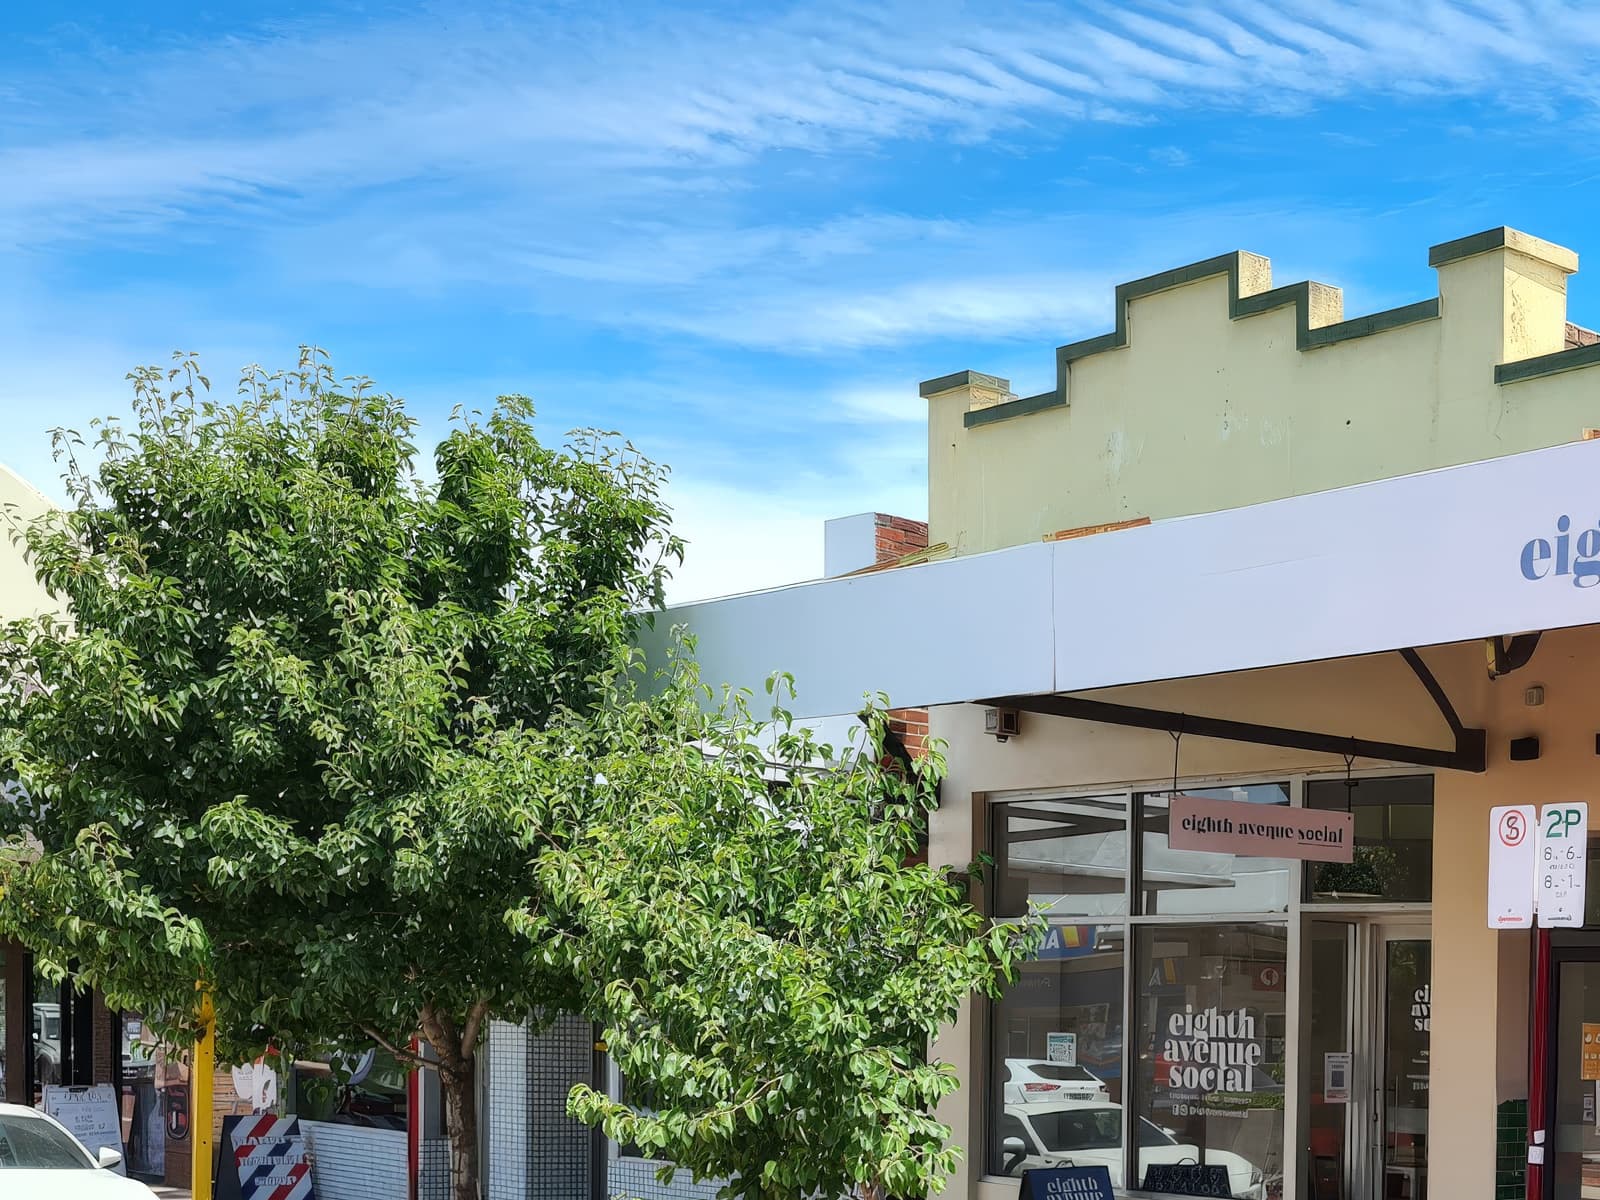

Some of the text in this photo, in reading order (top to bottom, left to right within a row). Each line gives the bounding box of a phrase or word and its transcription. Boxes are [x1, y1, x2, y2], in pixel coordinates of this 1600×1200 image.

[1181, 814, 1343, 844] eighth avenue social
[1545, 808, 1582, 839] 2P
[1168, 1004, 1255, 1042] eighth
[1163, 1038, 1261, 1069] avenue
[1168, 1064, 1253, 1093] social
[1046, 1177, 1099, 1193] eighth
